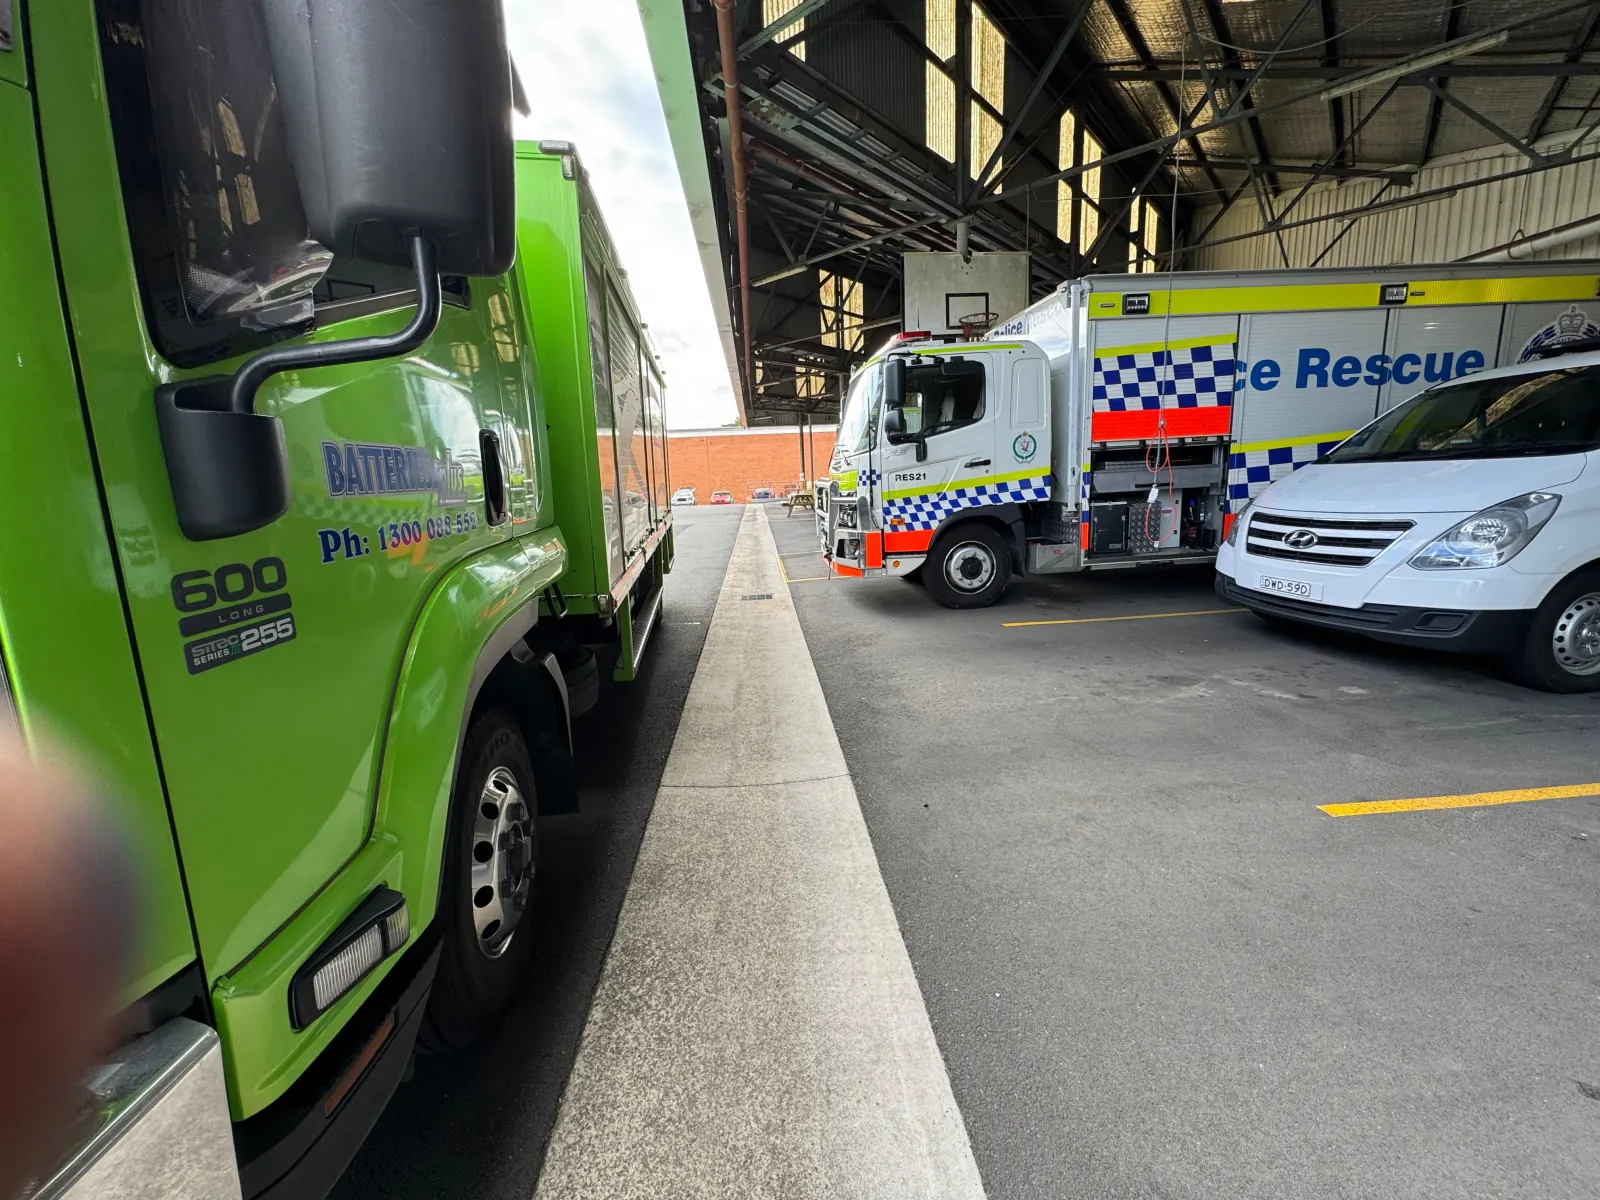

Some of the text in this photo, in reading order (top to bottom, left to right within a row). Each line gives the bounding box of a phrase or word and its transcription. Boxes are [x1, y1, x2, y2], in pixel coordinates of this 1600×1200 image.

[1295, 347, 1485, 388] Rescue
[895, 472, 927, 482] RES21
[318, 527, 370, 563] Ph:
[377, 520, 422, 551] 1300
[426, 515, 451, 540] 088
[170, 556, 288, 613] 600
[218, 604, 265, 624] LONG
[240, 617, 294, 652] 255
[193, 648, 230, 666] SERIES
